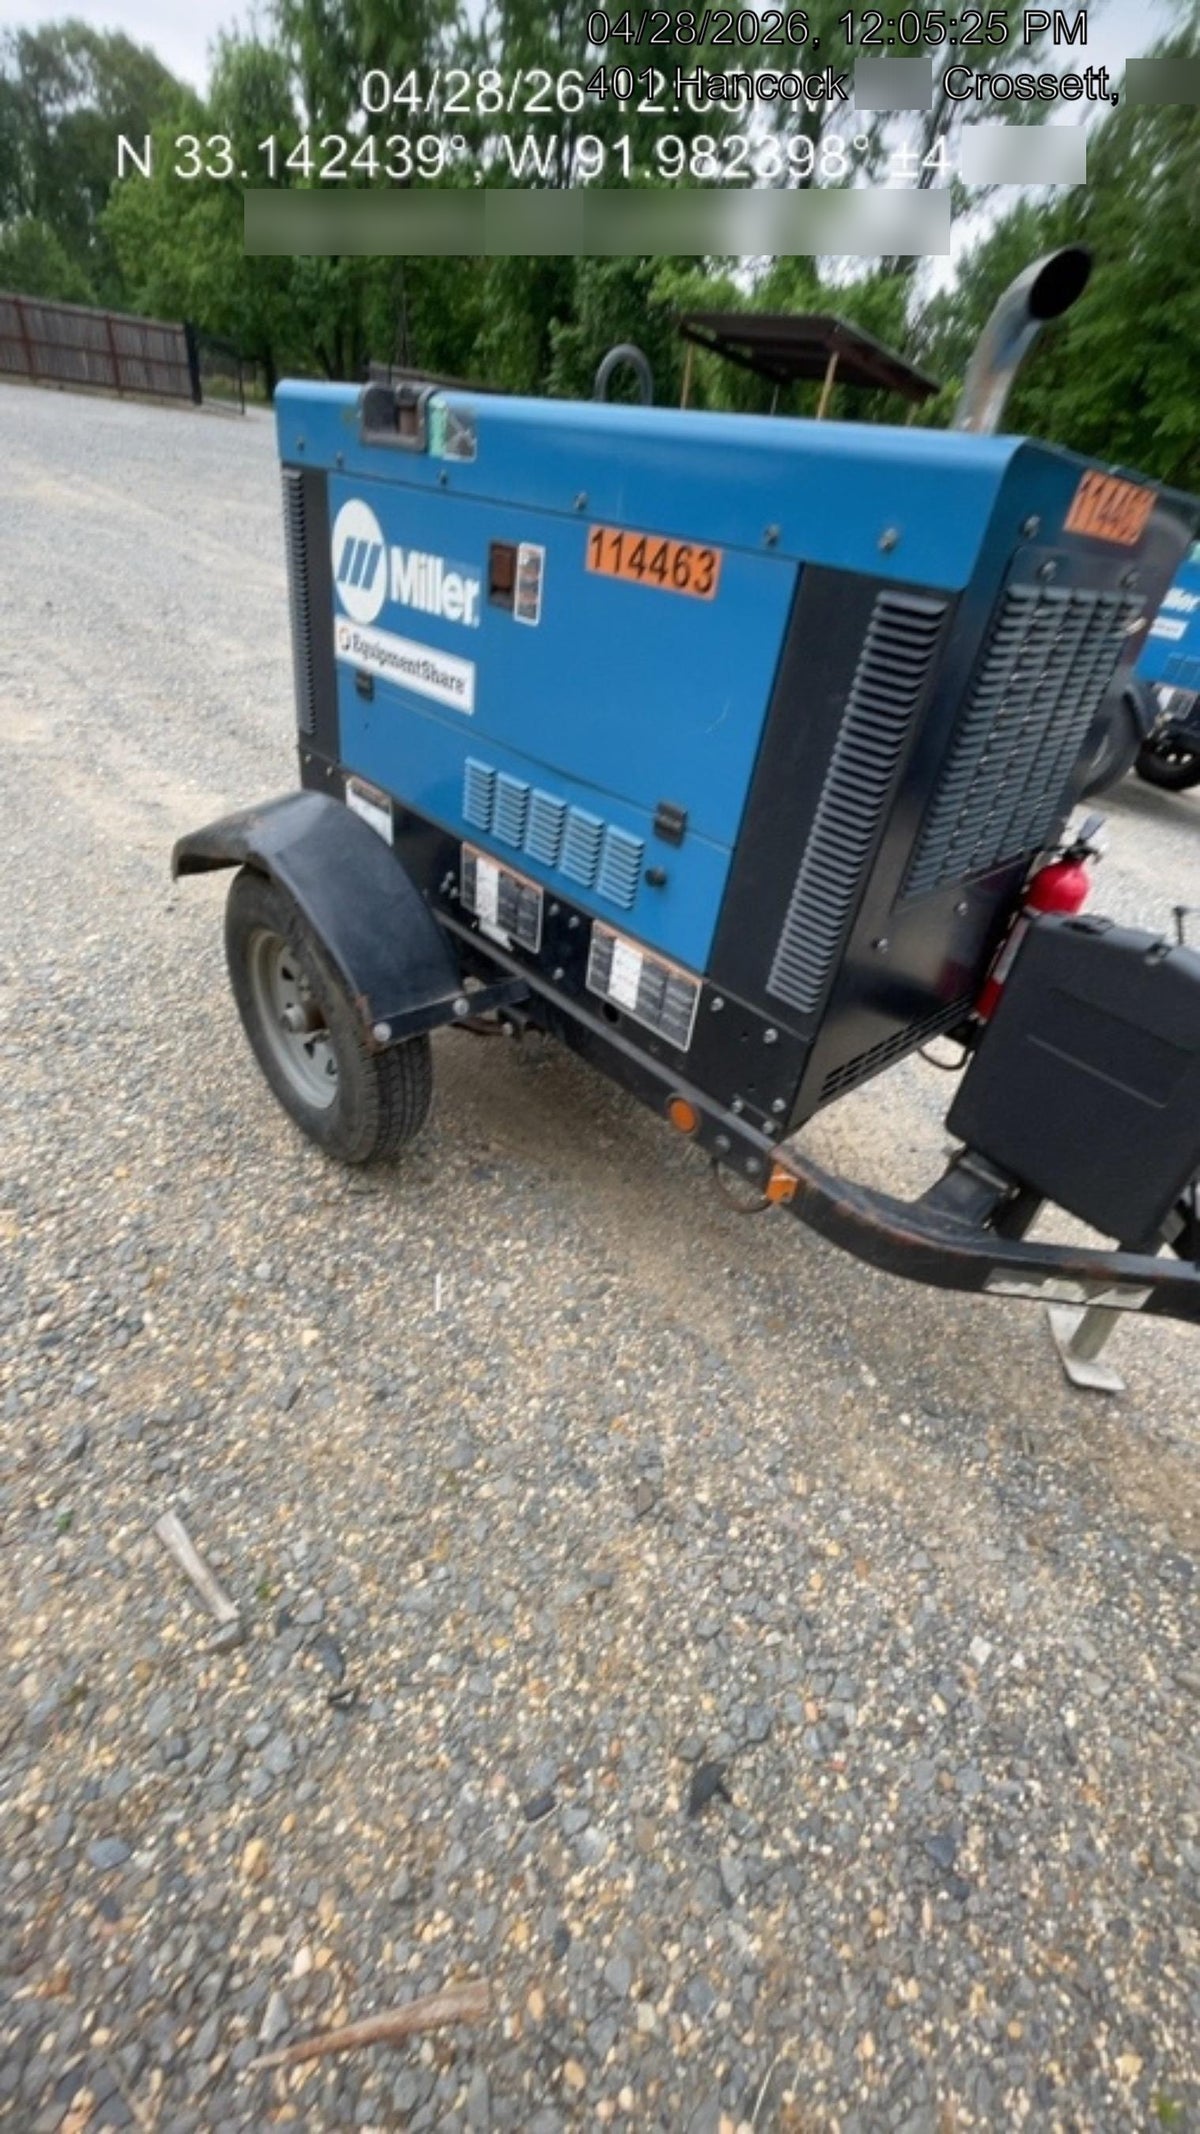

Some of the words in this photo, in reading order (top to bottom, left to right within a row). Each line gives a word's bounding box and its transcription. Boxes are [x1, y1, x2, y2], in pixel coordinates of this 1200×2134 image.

[390, 545, 480, 628] Miller
[591, 528, 715, 593] 114463
[352, 633, 466, 695] EquipmentShare
